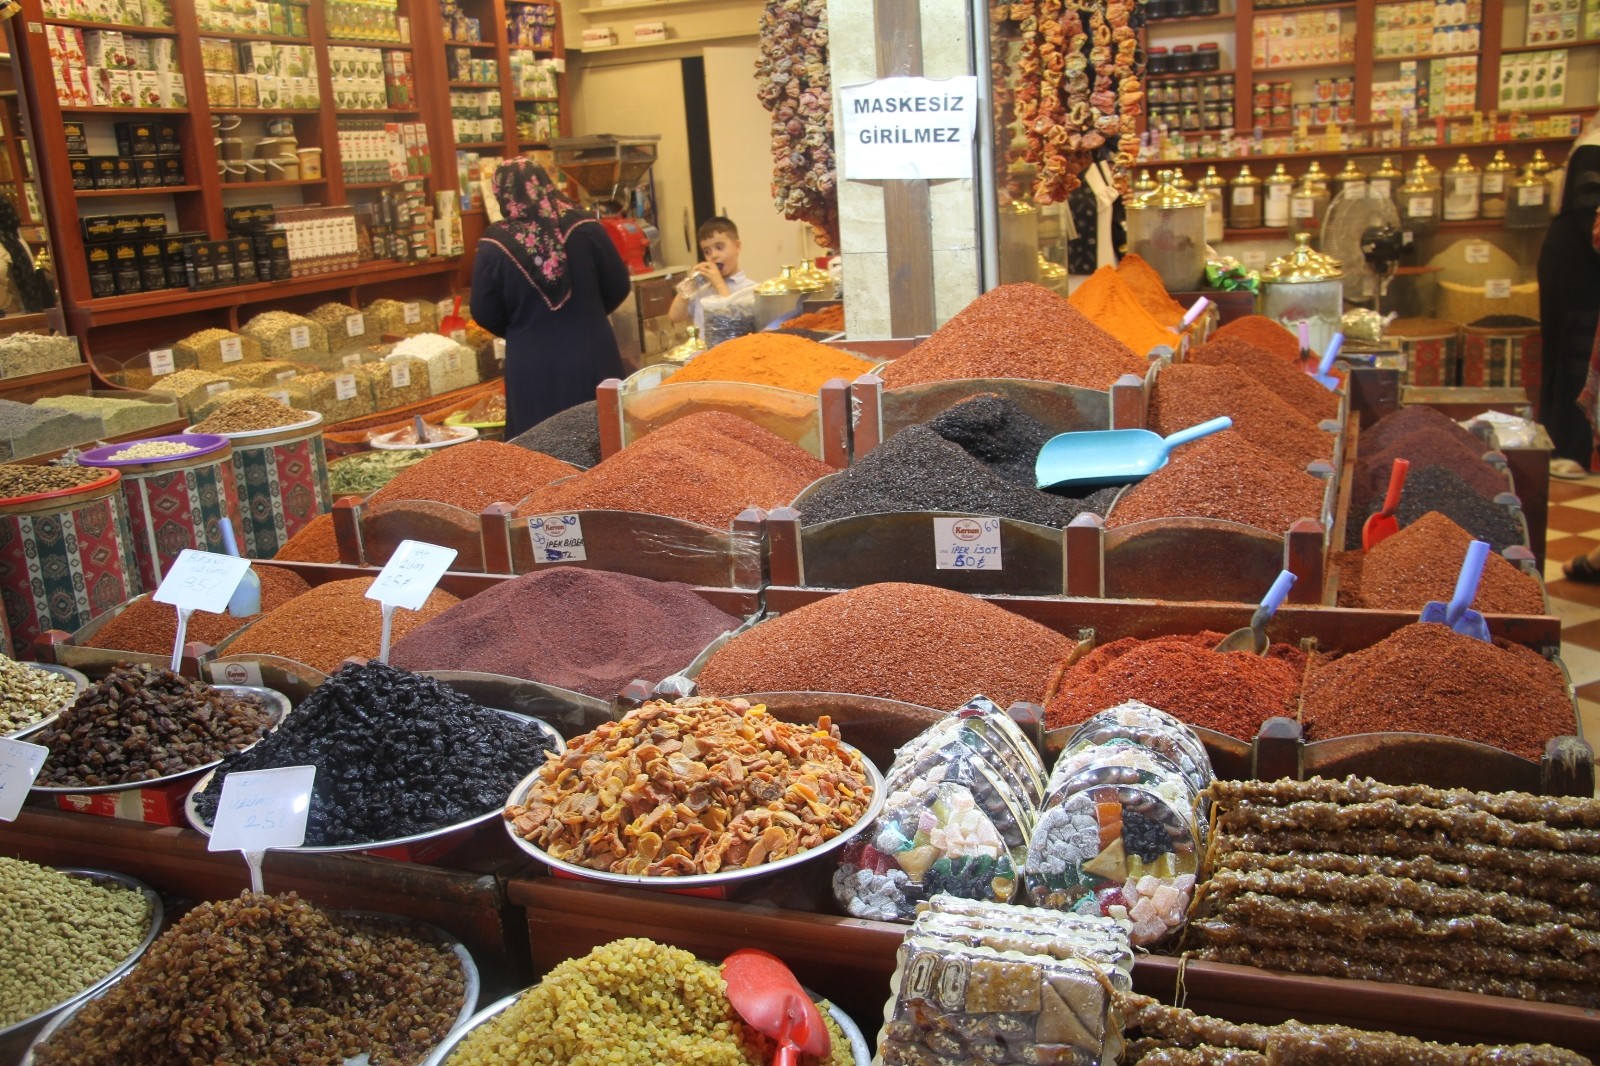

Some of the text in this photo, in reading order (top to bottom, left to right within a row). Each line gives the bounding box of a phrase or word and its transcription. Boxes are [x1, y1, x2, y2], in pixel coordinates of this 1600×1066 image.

[854, 93, 964, 114] MASKESİZ
[859, 125, 960, 144] GİRİLMEZ
[984, 519, 998, 532] 60
